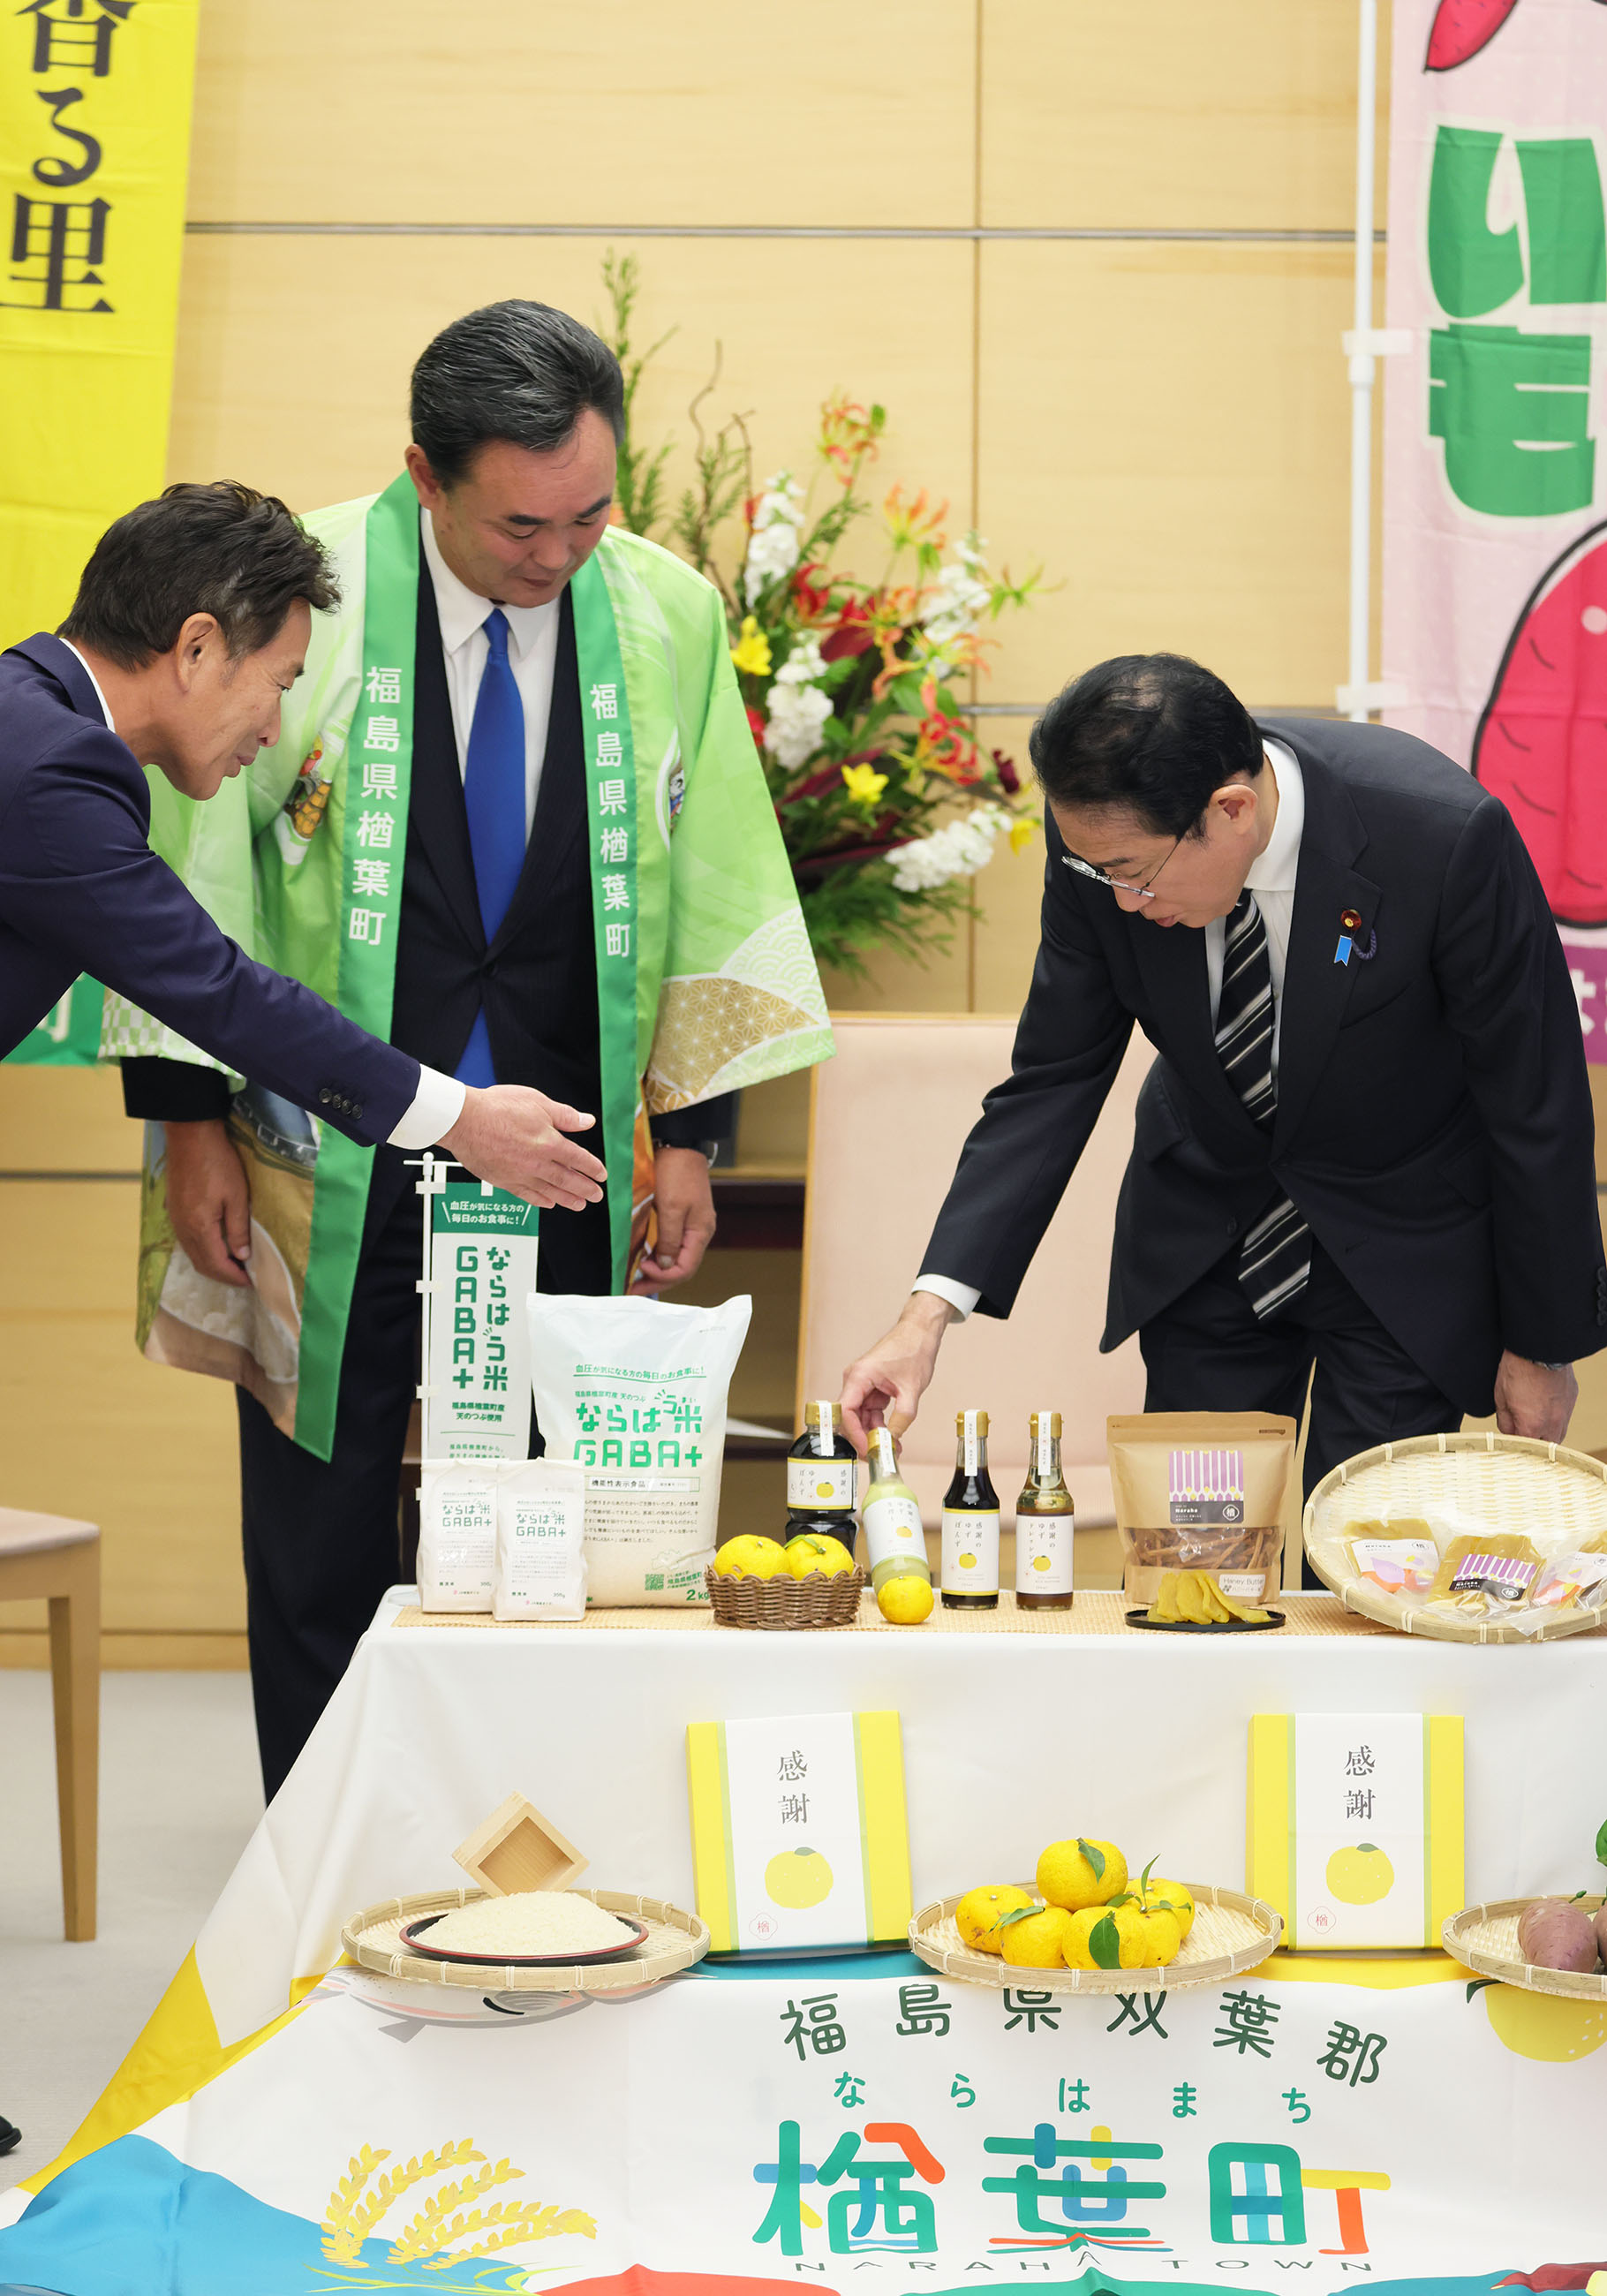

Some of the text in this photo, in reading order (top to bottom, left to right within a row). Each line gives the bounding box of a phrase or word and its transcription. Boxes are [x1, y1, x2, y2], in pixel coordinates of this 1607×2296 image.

[1427, 125, 1607, 517] いも
[349, 667, 402, 946] 福島県楢葉町
[590, 684, 631, 958] 福島県楢葉町
[450, 1201, 524, 1212] 血圧が気になる方の
[452, 1213, 519, 1225] 毎日のお食事に！
[452, 1246, 479, 1389] GABA+
[483, 1246, 511, 1392] ならはう米
[576, 1364, 705, 1380] 血圧が気になる方の毎日のお食事に！
[574, 1439, 703, 1468] GABA+
[442, 1516, 492, 1527] GABA+
[516, 1526, 566, 1537] GABA+
[777, 1749, 811, 1824] 感謝
[1343, 1745, 1377, 1820] 感謝
[781, 1983, 1387, 2088] 福島県双葉郡
[834, 2071, 1312, 2124] ならはまち
[752, 2119, 1392, 2256] 楢葉町
[795, 2251, 1372, 2271] NARAHA TOWN
